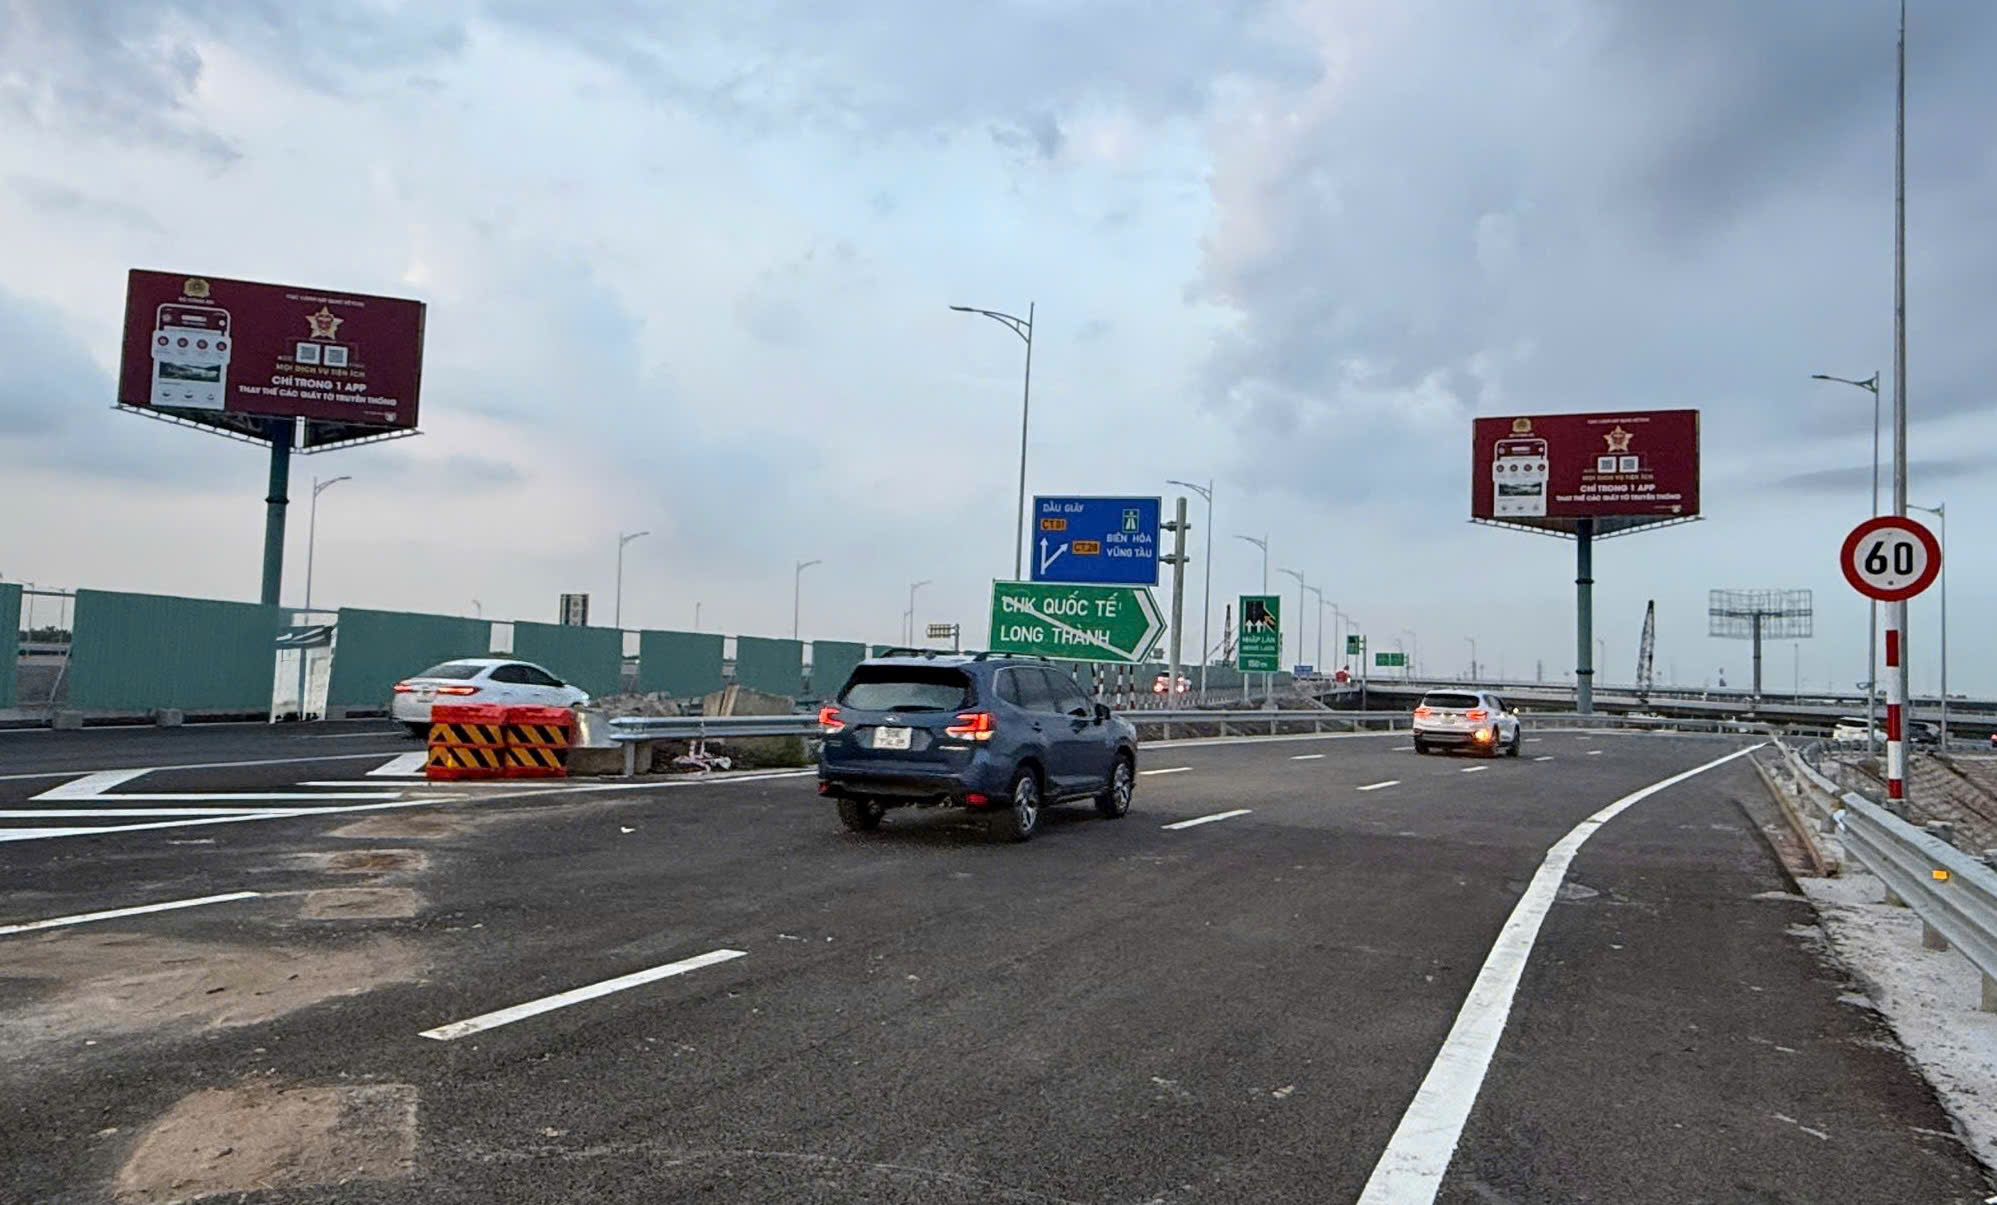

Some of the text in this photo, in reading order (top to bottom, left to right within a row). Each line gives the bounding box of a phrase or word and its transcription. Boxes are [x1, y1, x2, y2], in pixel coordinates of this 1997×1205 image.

[238, 385, 261, 395] THAY
[279, 387, 298, 398] CÁC
[295, 378, 333, 391] TRONG
[336, 381, 342, 391] 1
[344, 382, 367, 392] APP
[1598, 484, 1628, 492] TRONG
[1637, 484, 1656, 492] APP
[1043, 500, 1061, 512] DẦU
[1106, 547, 1153, 558] VŨNG TÀU
[1865, 541, 1913, 575] 60
[1001, 590, 1118, 617] CHK QUỐC TẾ
[1000, 624, 1110, 645] LONG THÀNH
